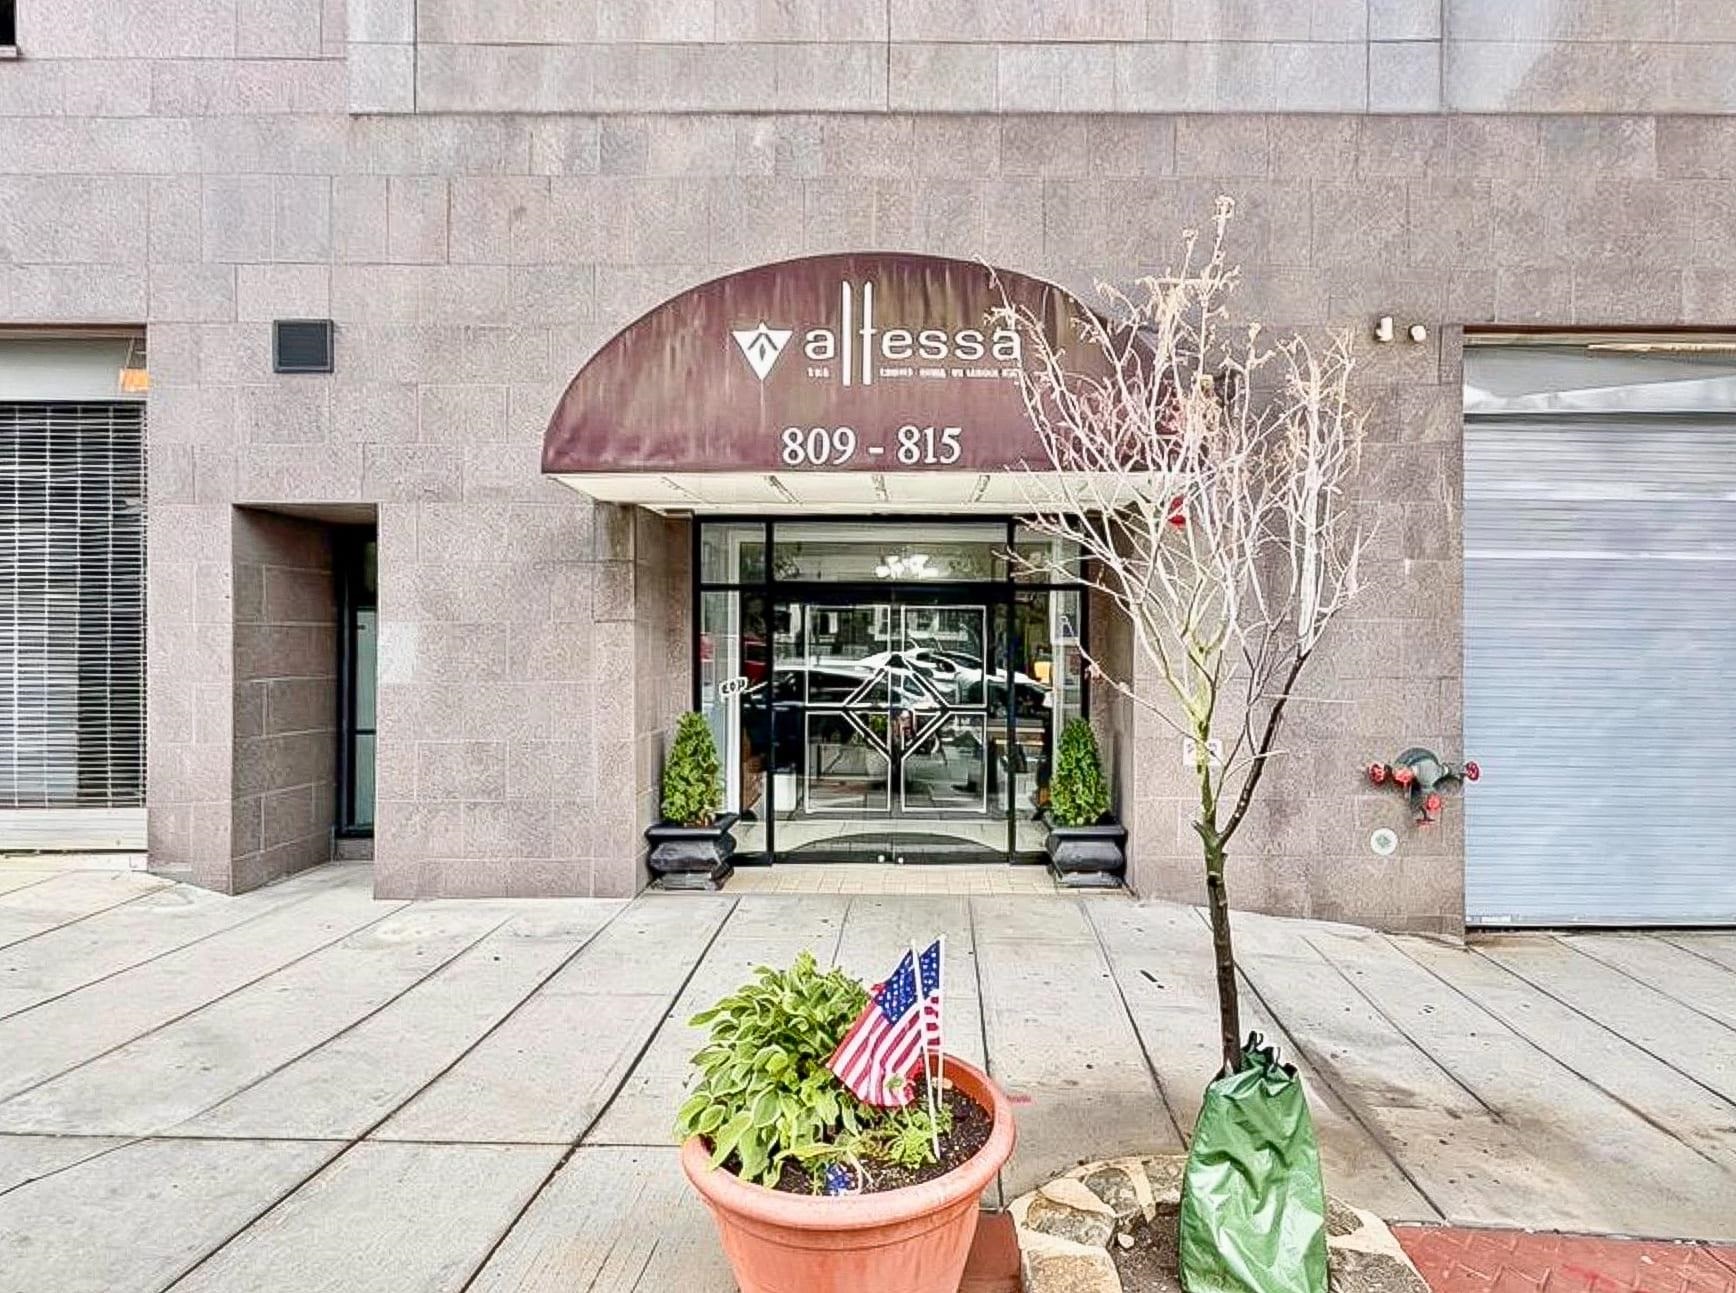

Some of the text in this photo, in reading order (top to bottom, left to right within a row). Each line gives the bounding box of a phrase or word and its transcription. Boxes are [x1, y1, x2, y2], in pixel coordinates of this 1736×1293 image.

[804, 280, 1021, 387] altessa
[781, 427, 856, 465] 809
[897, 425, 962, 464] 815
